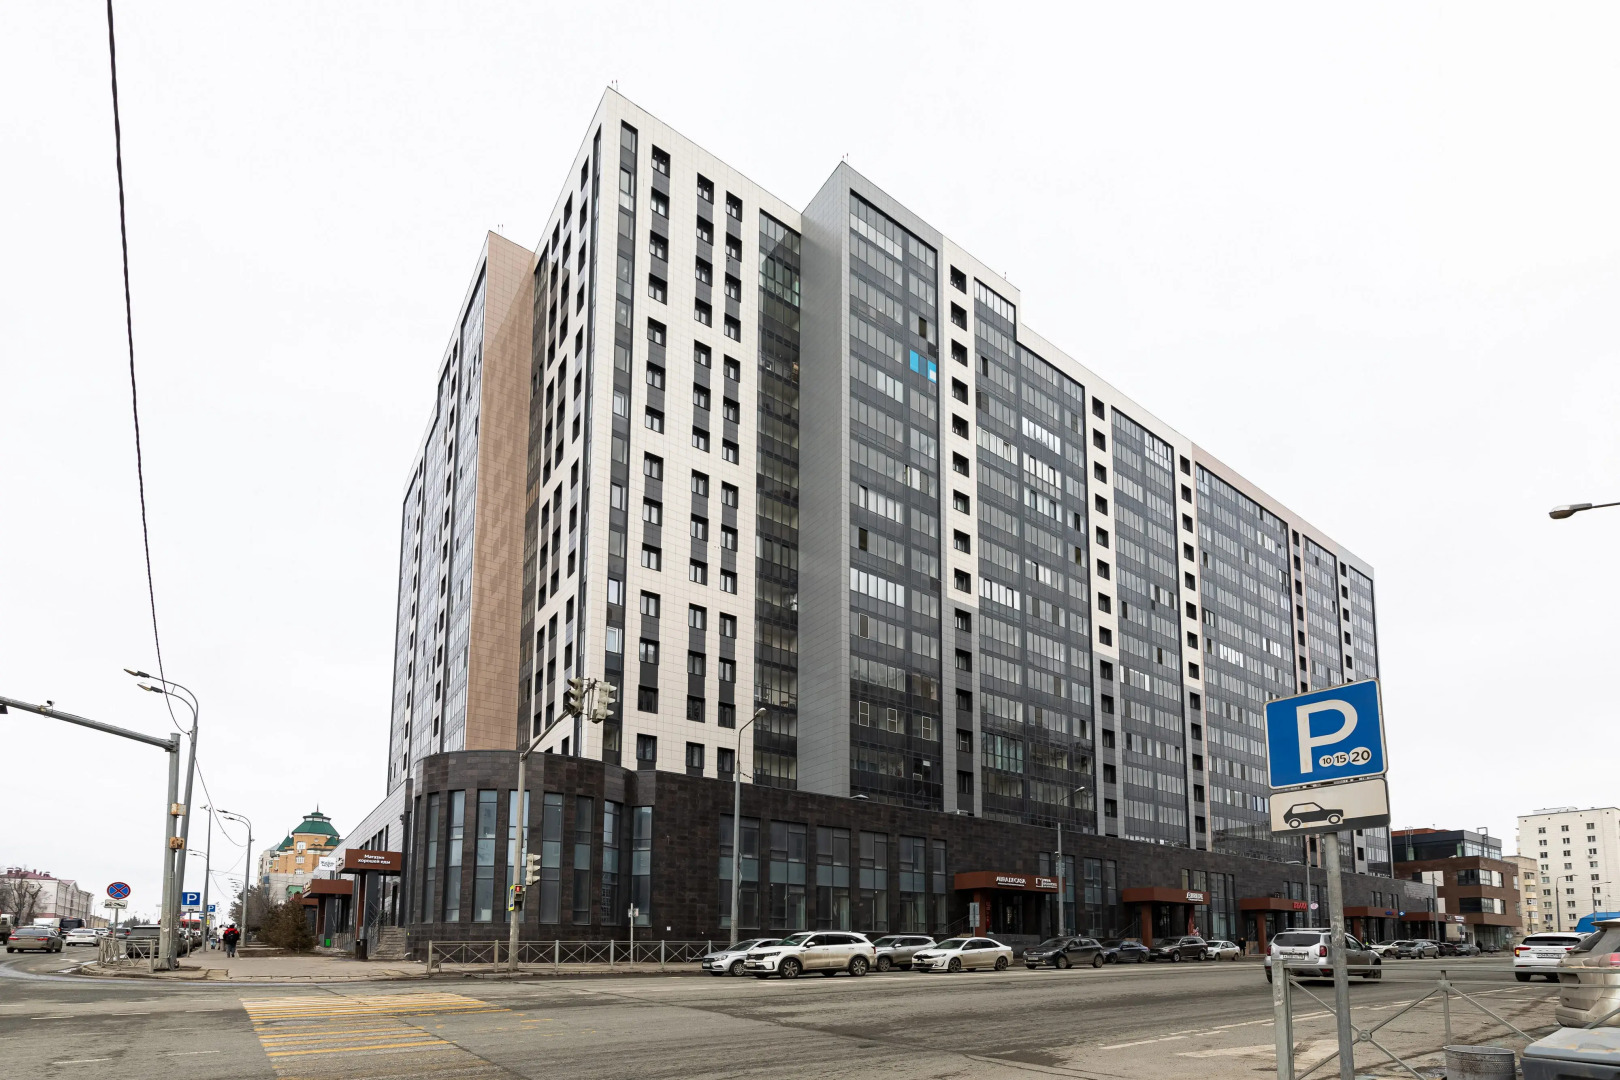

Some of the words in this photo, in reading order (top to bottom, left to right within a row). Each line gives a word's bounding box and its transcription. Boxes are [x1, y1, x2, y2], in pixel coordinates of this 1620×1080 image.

[1296, 699, 1358, 774] P
[1322, 757, 1332, 765] 10
[1335, 754, 1347, 764] 15
[1351, 750, 1371, 763] 20
[187, 893, 198, 905] P
